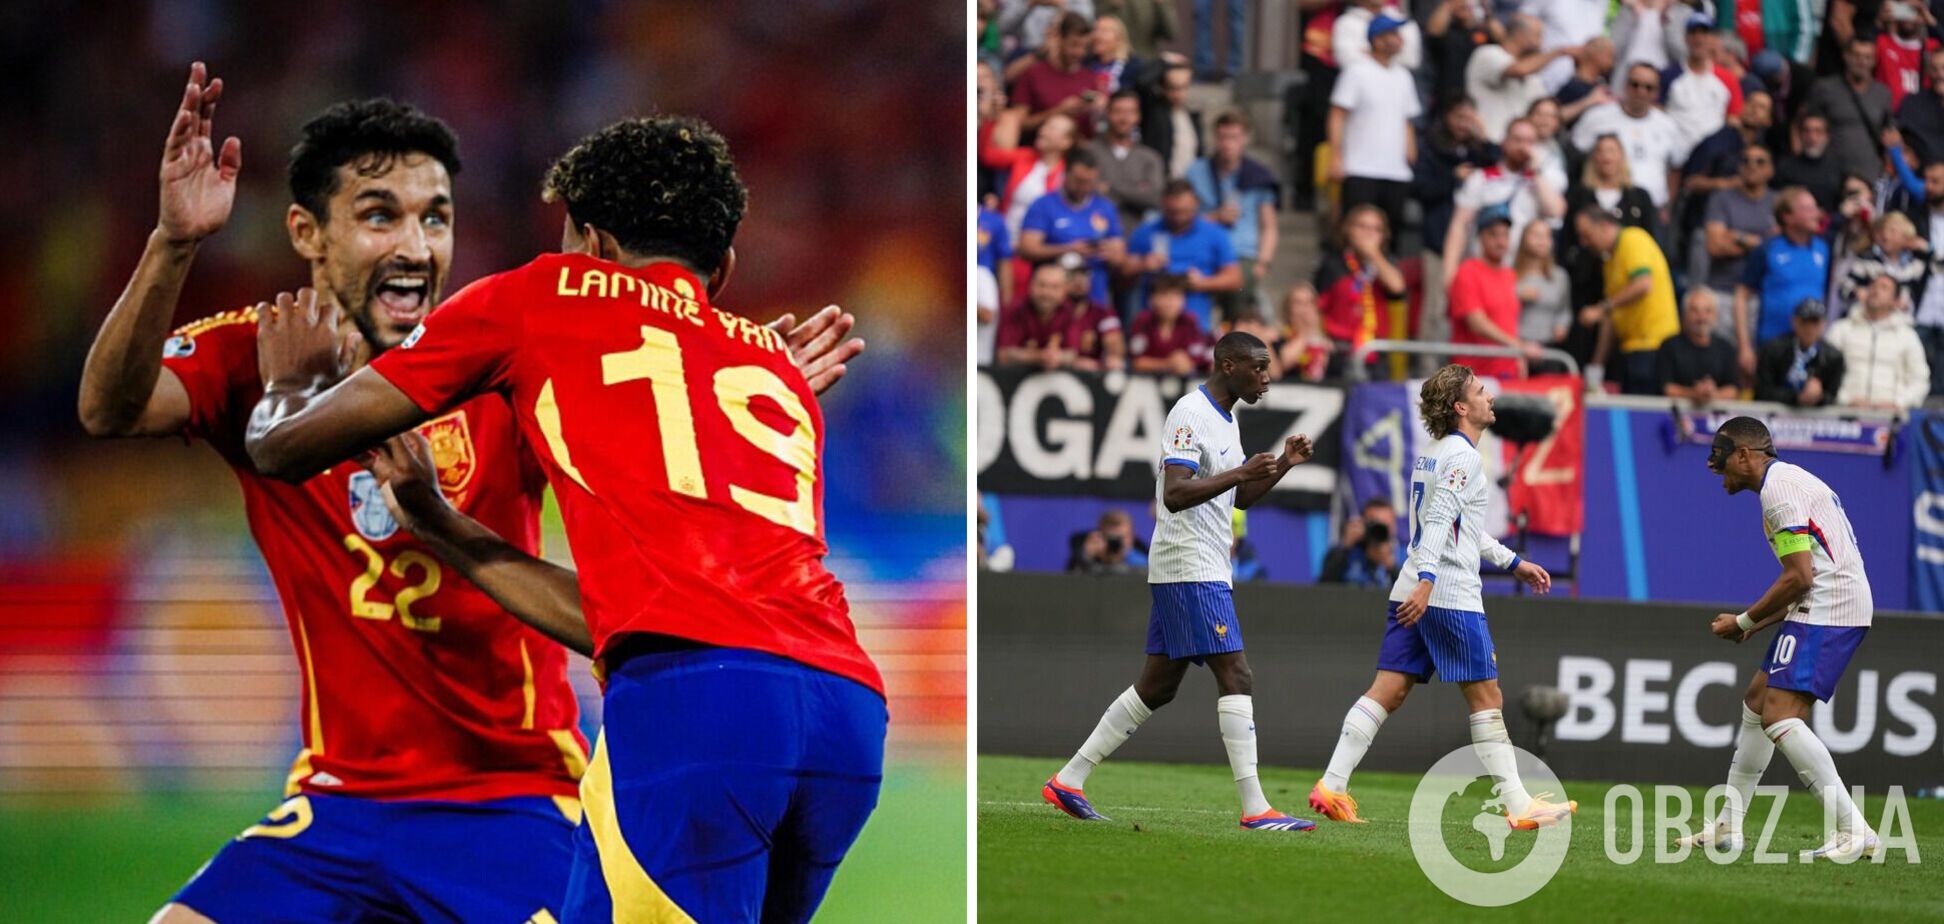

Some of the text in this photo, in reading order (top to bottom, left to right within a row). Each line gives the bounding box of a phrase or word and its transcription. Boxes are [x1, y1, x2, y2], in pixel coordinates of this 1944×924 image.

[557, 266, 705, 327] LAMINE
[601, 324, 817, 537] 19
[1412, 482, 1425, 549] 7
[343, 533, 442, 632] 22
[1772, 634, 1797, 665] 10
[1556, 655, 1938, 757] BECUS
